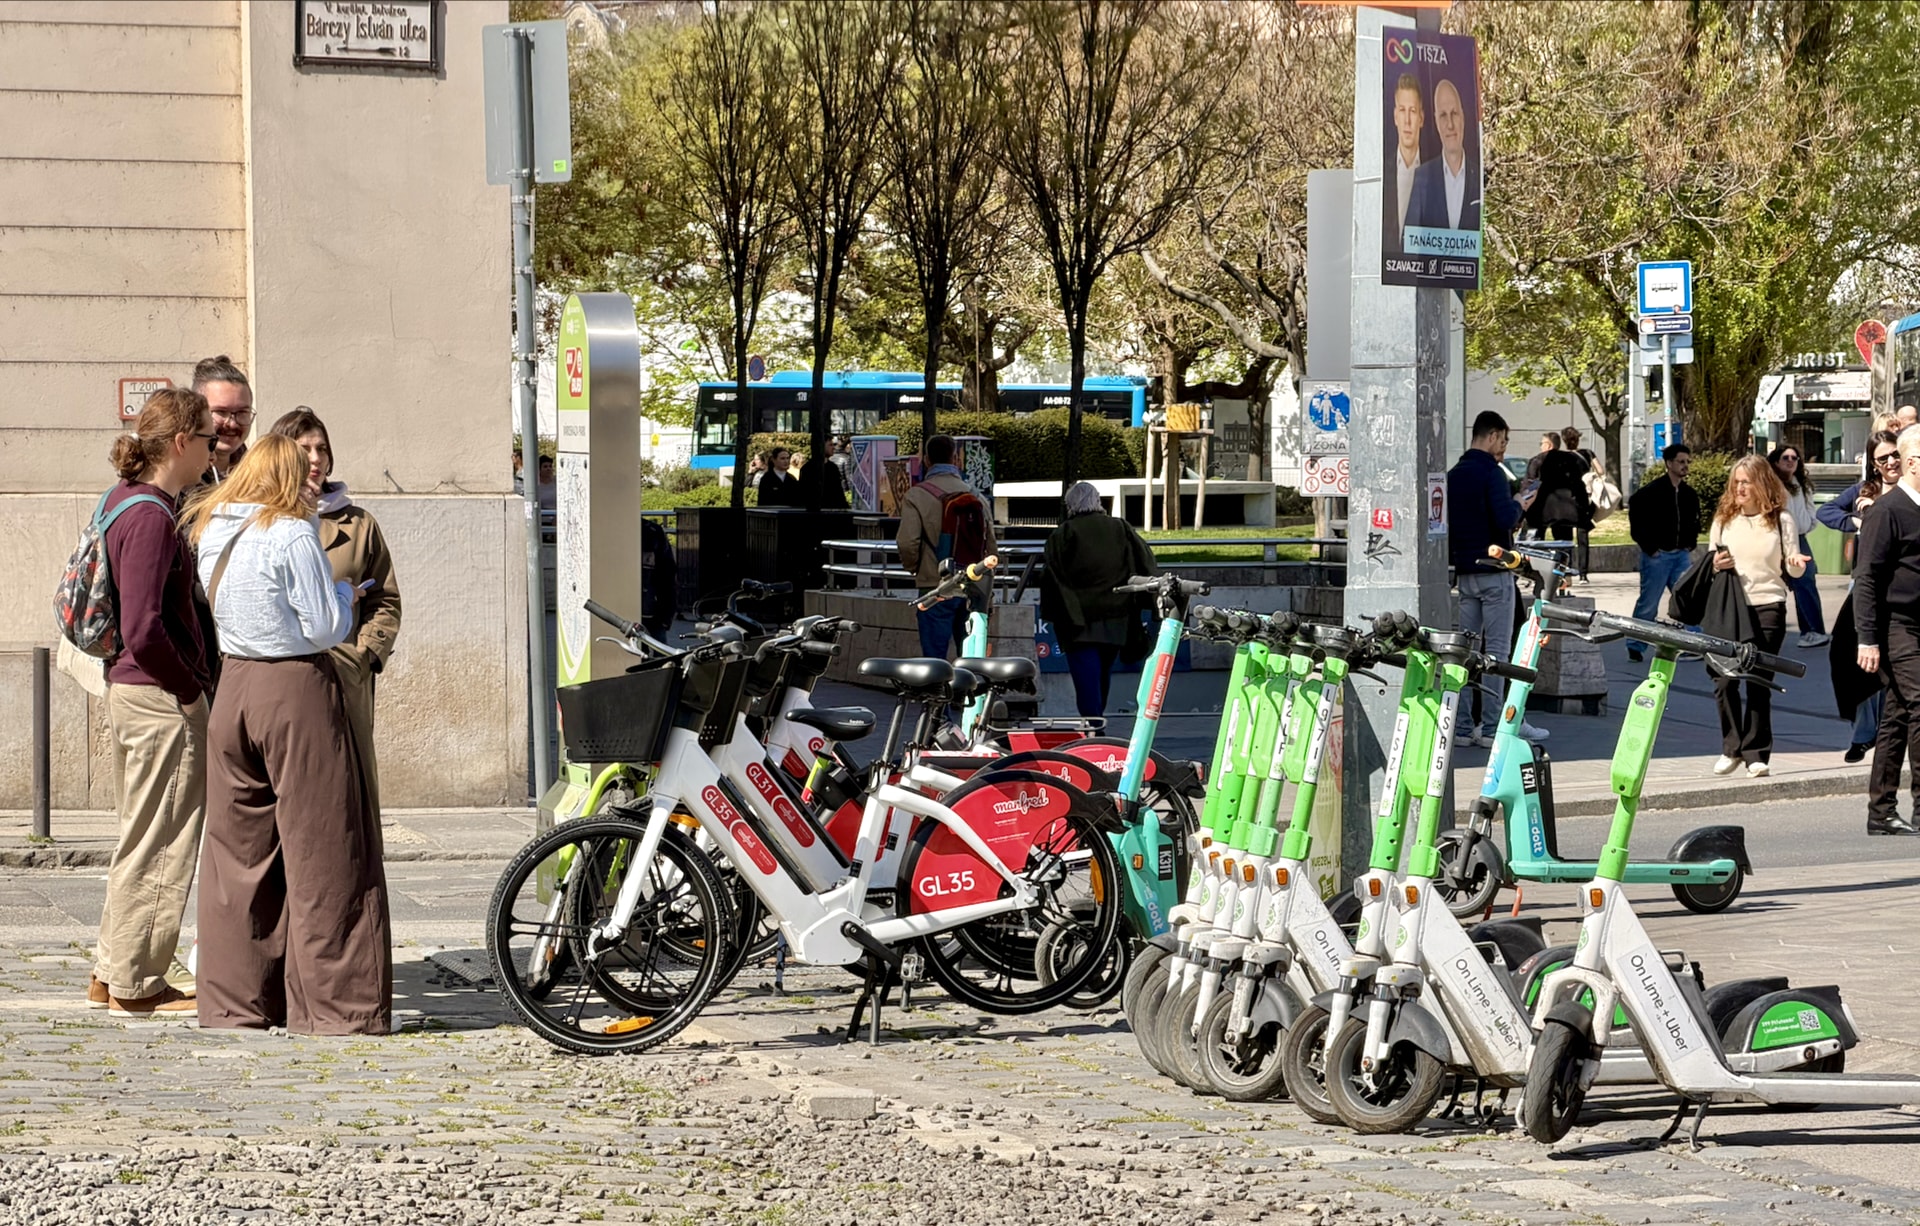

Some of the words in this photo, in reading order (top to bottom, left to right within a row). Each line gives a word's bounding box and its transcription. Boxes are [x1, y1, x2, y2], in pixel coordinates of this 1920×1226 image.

[307, 13, 350, 45] Bárczy
[356, 15, 394, 40] István
[400, 17, 427, 41] utca
[1416, 45, 1448, 65] TISZA
[1409, 232, 1443, 248] TANÁCS
[1444, 235, 1477, 250] ZOLTÁN
[1385, 259, 1425, 273] SZAVAZZ!
[1039, 645, 1046, 655] 2
[749, 765, 773, 794] GL31
[704, 788, 733, 820] GL35
[993, 787, 1049, 815] manfred
[1176, 830, 1184, 857] TIER
[1531, 826, 1543, 853] dott
[1159, 850, 1172, 874] K311
[919, 870, 976, 898] GL35
[1147, 901, 1163, 932] dott
[1315, 930, 1329, 950] On
[1326, 947, 1341, 975] Lim
[1631, 955, 1647, 976] On
[1456, 959, 1471, 979] On
[1468, 977, 1491, 1008] Lime
[1494, 1016, 1517, 1047] Uber
[1641, 975, 1664, 1009] Lime
[1662, 1009, 1670, 1017] +
[1665, 1017, 1689, 1050] Uber
